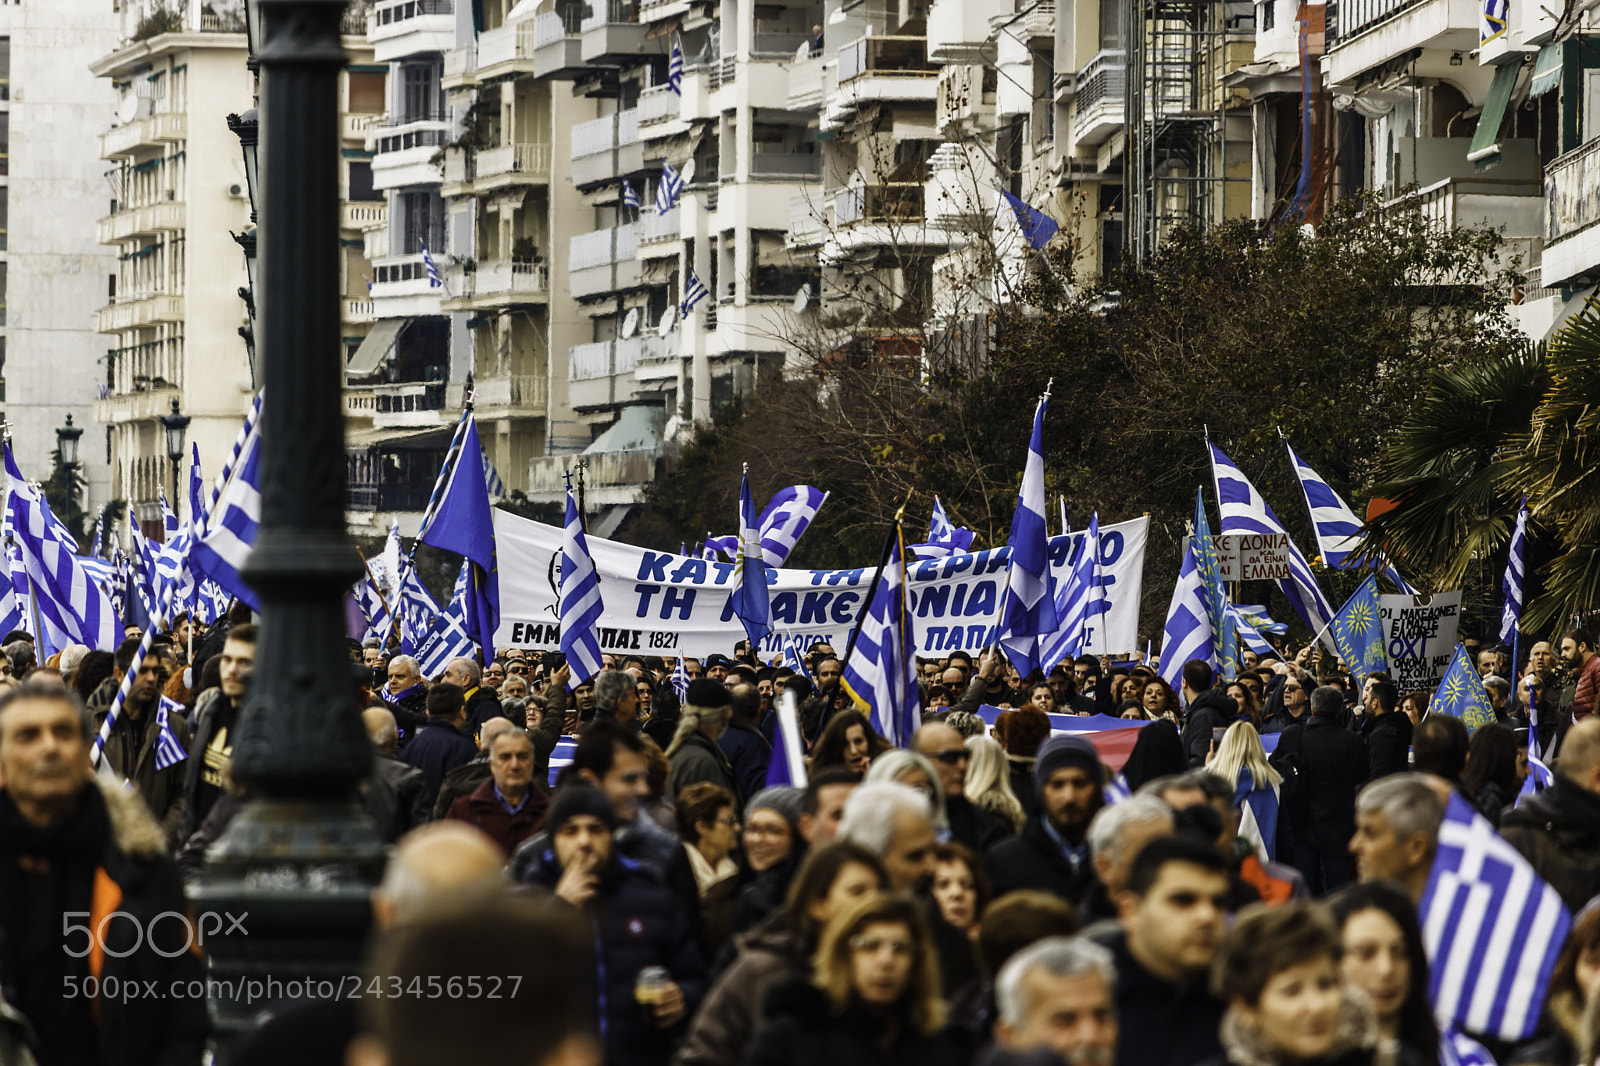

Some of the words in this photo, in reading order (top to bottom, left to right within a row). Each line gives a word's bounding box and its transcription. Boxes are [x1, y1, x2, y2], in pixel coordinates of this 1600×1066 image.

[809, 568, 865, 586] ΤΑ
[907, 546, 1011, 582] ΕΡΙΑ
[635, 584, 697, 620] ΤΗ
[649, 632, 679, 649] 1821
[1388, 637, 1427, 659] ΟΧΙ
